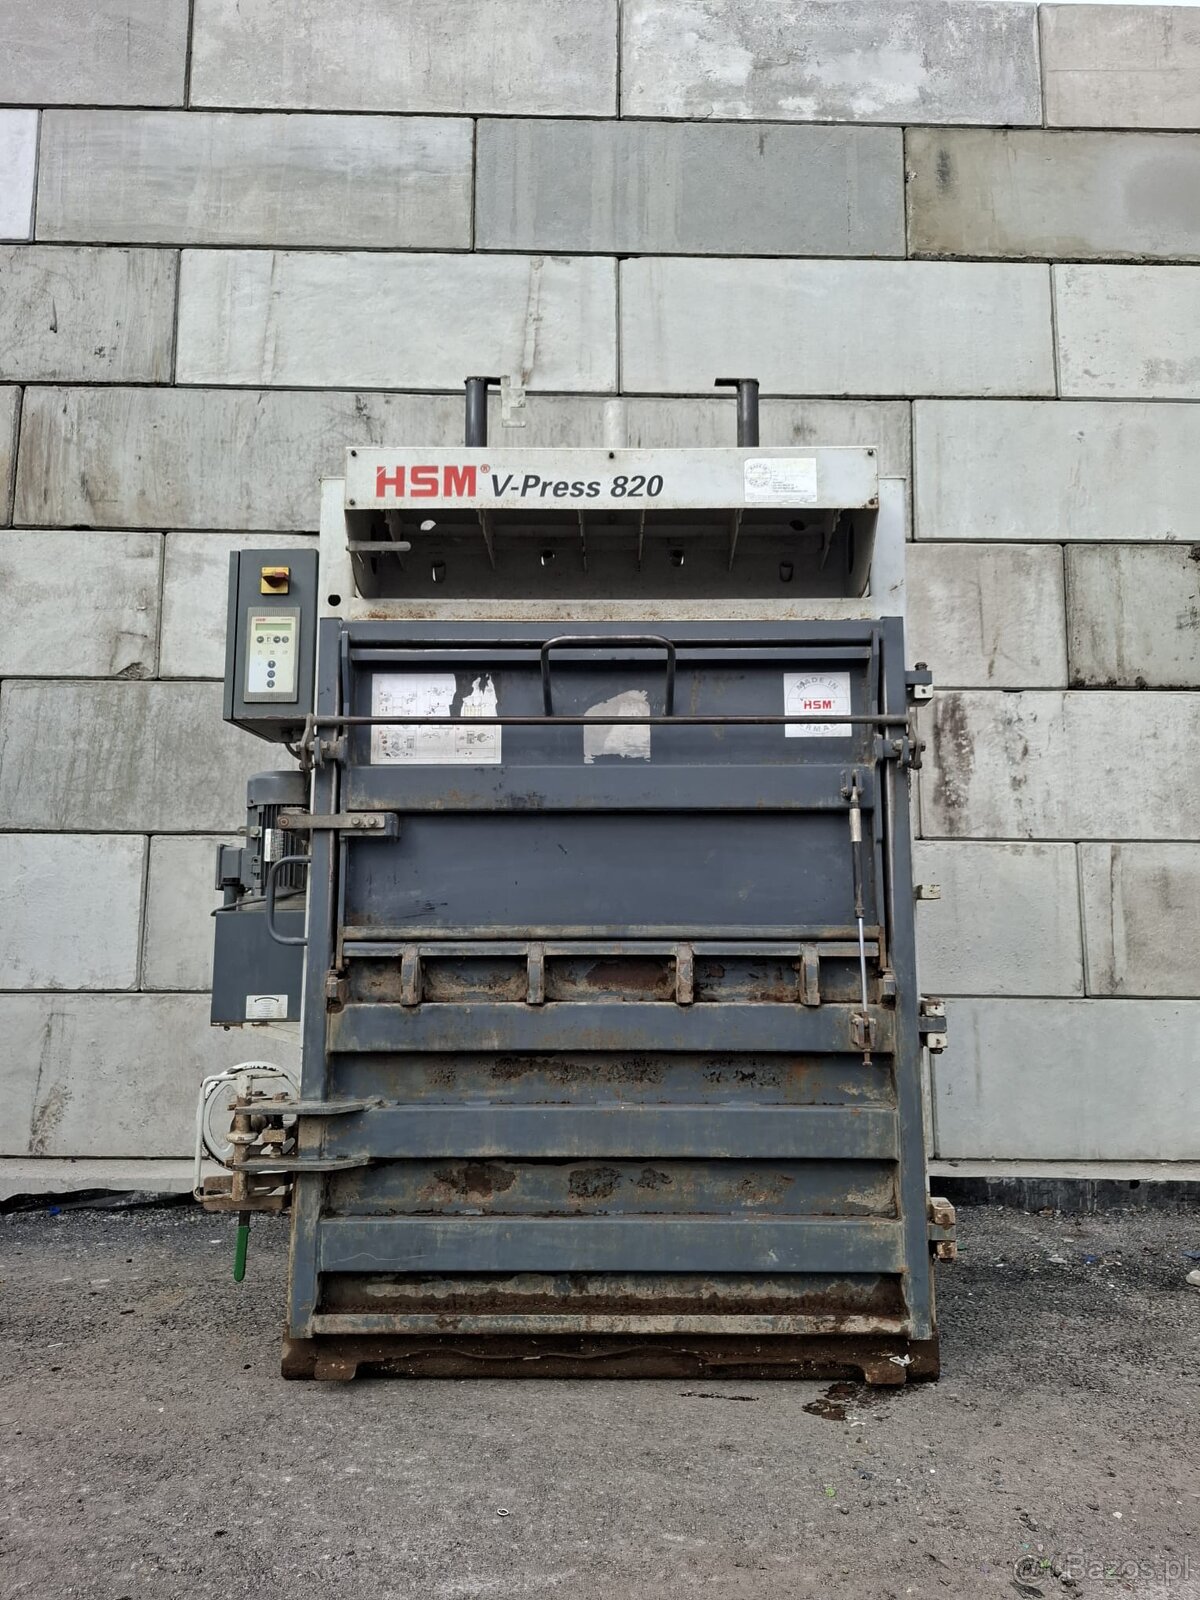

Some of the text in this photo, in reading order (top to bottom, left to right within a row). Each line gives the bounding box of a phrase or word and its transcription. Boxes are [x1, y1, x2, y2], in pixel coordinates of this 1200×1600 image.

[491, 474, 601, 498] V-Press
[610, 475, 664, 498] 820
[796, 677, 839, 691] MADE IN
[803, 700, 832, 710] HSM
